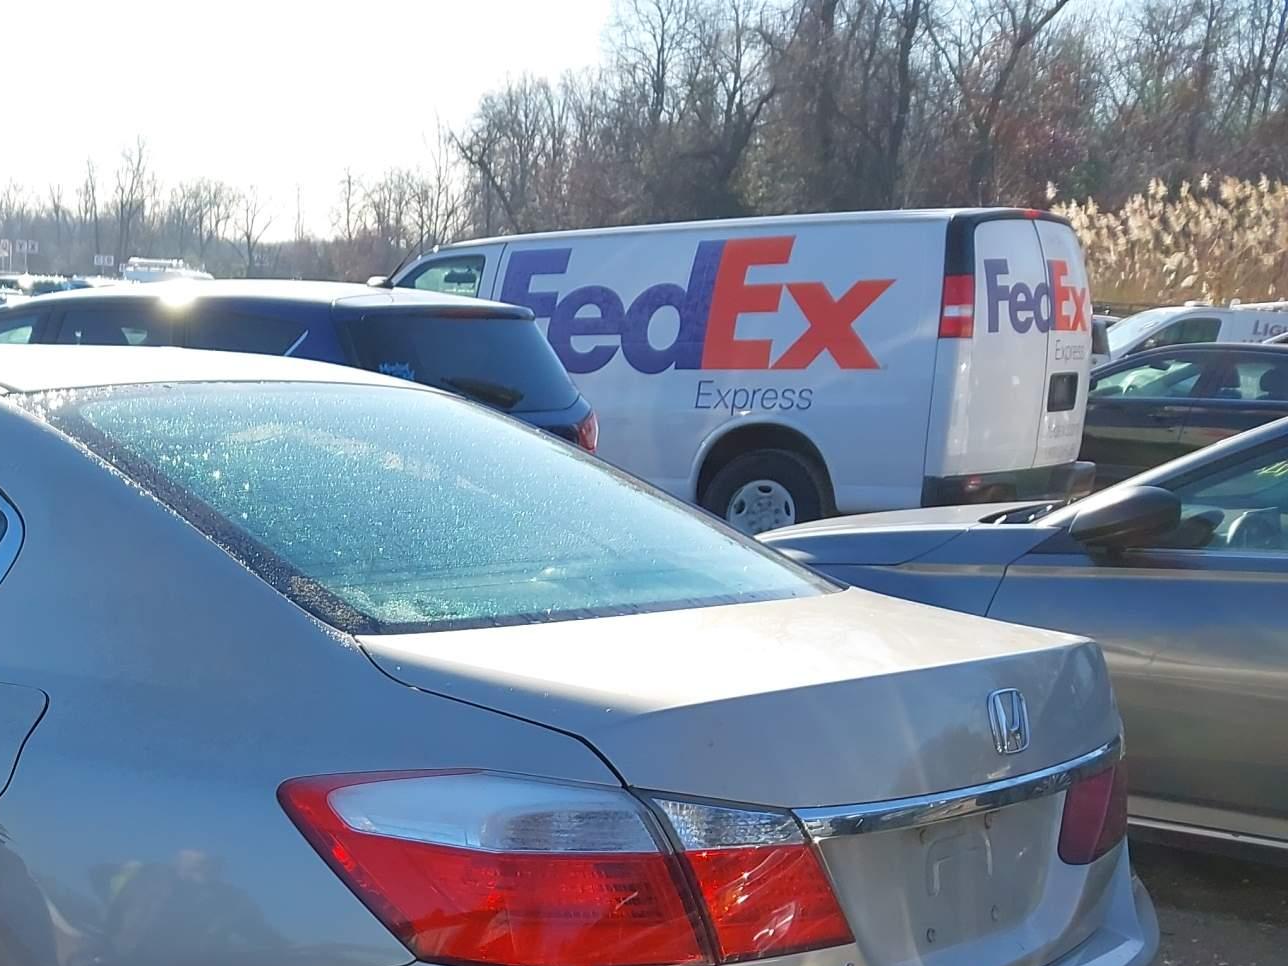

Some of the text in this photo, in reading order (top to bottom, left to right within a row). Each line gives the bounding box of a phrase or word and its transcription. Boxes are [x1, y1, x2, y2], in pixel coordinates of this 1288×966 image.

[502, 235, 896, 374] FedEx
[983, 258, 1087, 334] FedEx
[1055, 339, 1086, 363] Express
[694, 379, 813, 418] Express
